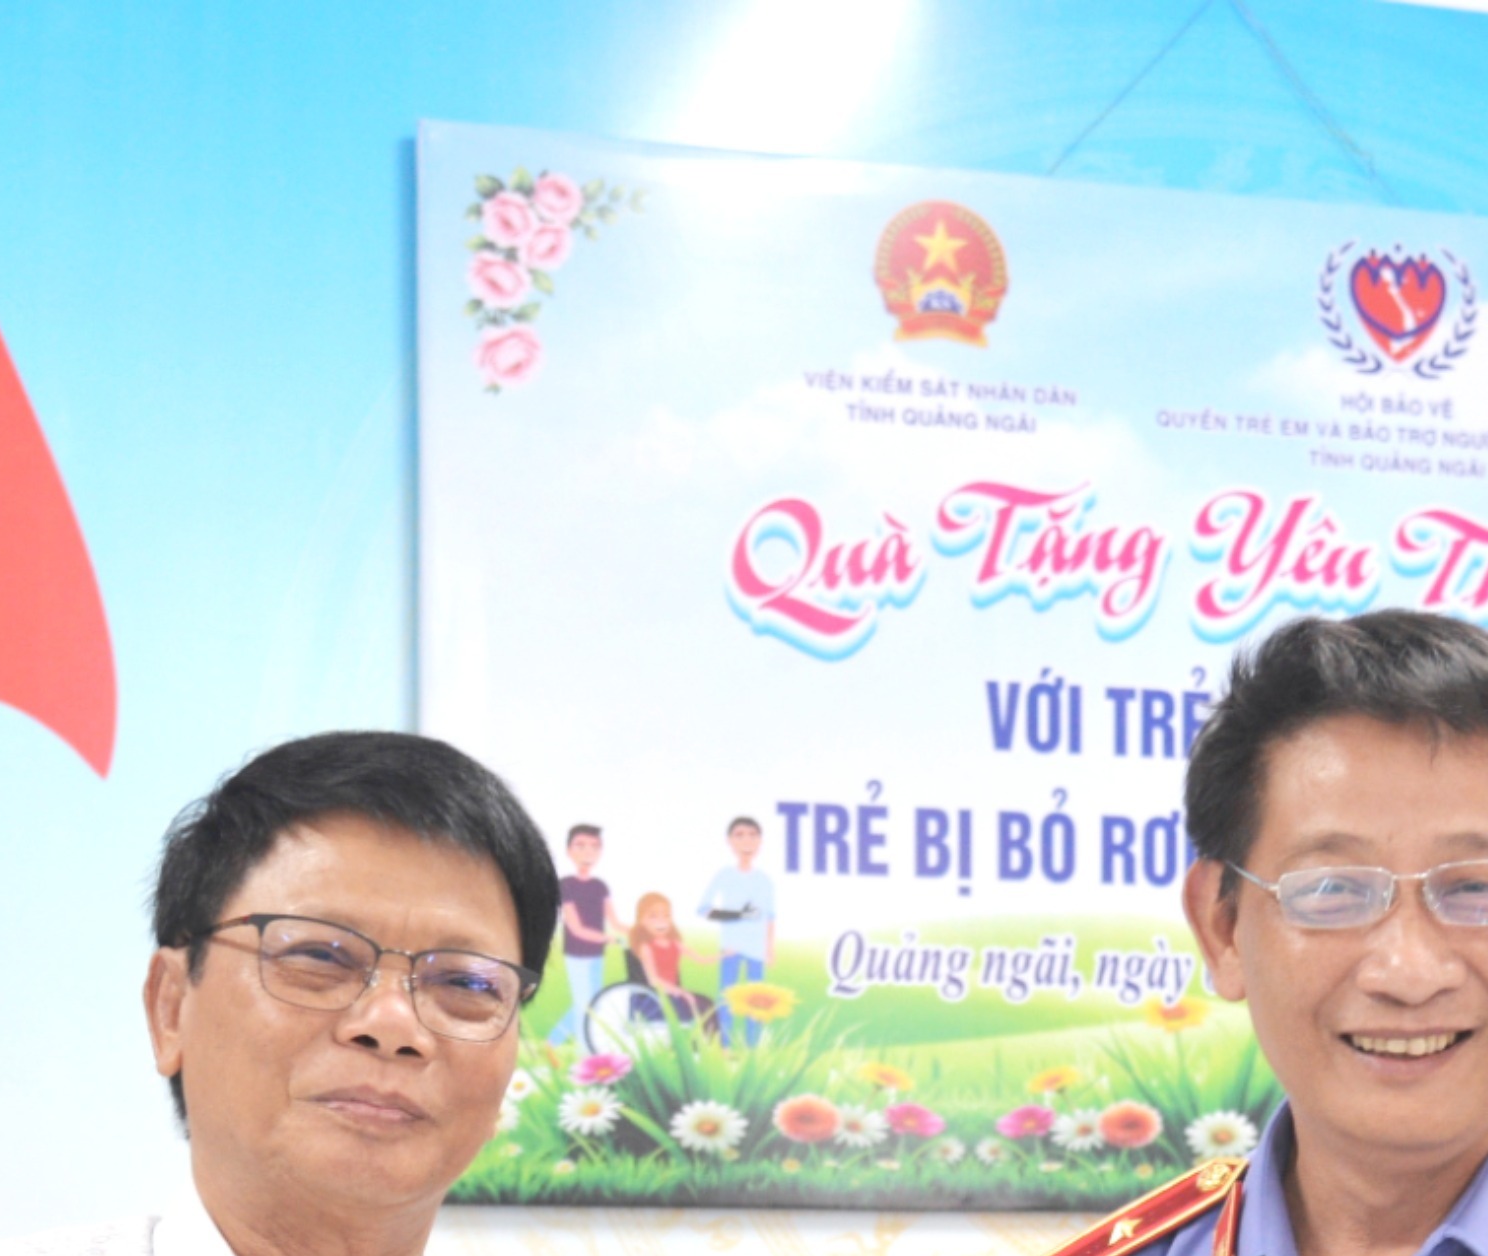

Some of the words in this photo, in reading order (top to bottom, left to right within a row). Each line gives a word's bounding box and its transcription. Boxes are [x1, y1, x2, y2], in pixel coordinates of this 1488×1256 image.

[804, 369, 853, 392] VIỆN
[861, 369, 911, 395] KIỂM
[920, 375, 958, 398] SÁT
[968, 382, 1025, 404] NHÂN
[1033, 385, 1077, 407] DÂN
[1340, 392, 1375, 414] HỘI
[1381, 392, 1423, 417] BẢO
[1429, 397, 1453, 420] VỆ
[846, 401, 894, 423] TỈNH
[902, 405, 978, 430] QUẢNG
[985, 412, 1036, 434] NGÃI
[1156, 407, 1227, 431] QUYỀN
[1236, 411, 1273, 434] TRẺ
[1281, 419, 1309, 436] EM
[1316, 419, 1342, 438] VÀ
[1349, 420, 1391, 442] BẢO
[1360, 450, 1432, 475] QUẢNG
[729, 495, 922, 641] Quà
[933, 478, 1166, 624] Tặng
[1192, 488, 1374, 624] Yêu
[985, 667, 1081, 755] VỚI
[776, 779, 889, 877] TRẺ
[915, 807, 972, 897] BỊ
[997, 787, 1076, 883] BỎ
[830, 929, 970, 998] Quảng
[982, 935, 1080, 998] ngãi,
[1096, 938, 1192, 1004] ngày
